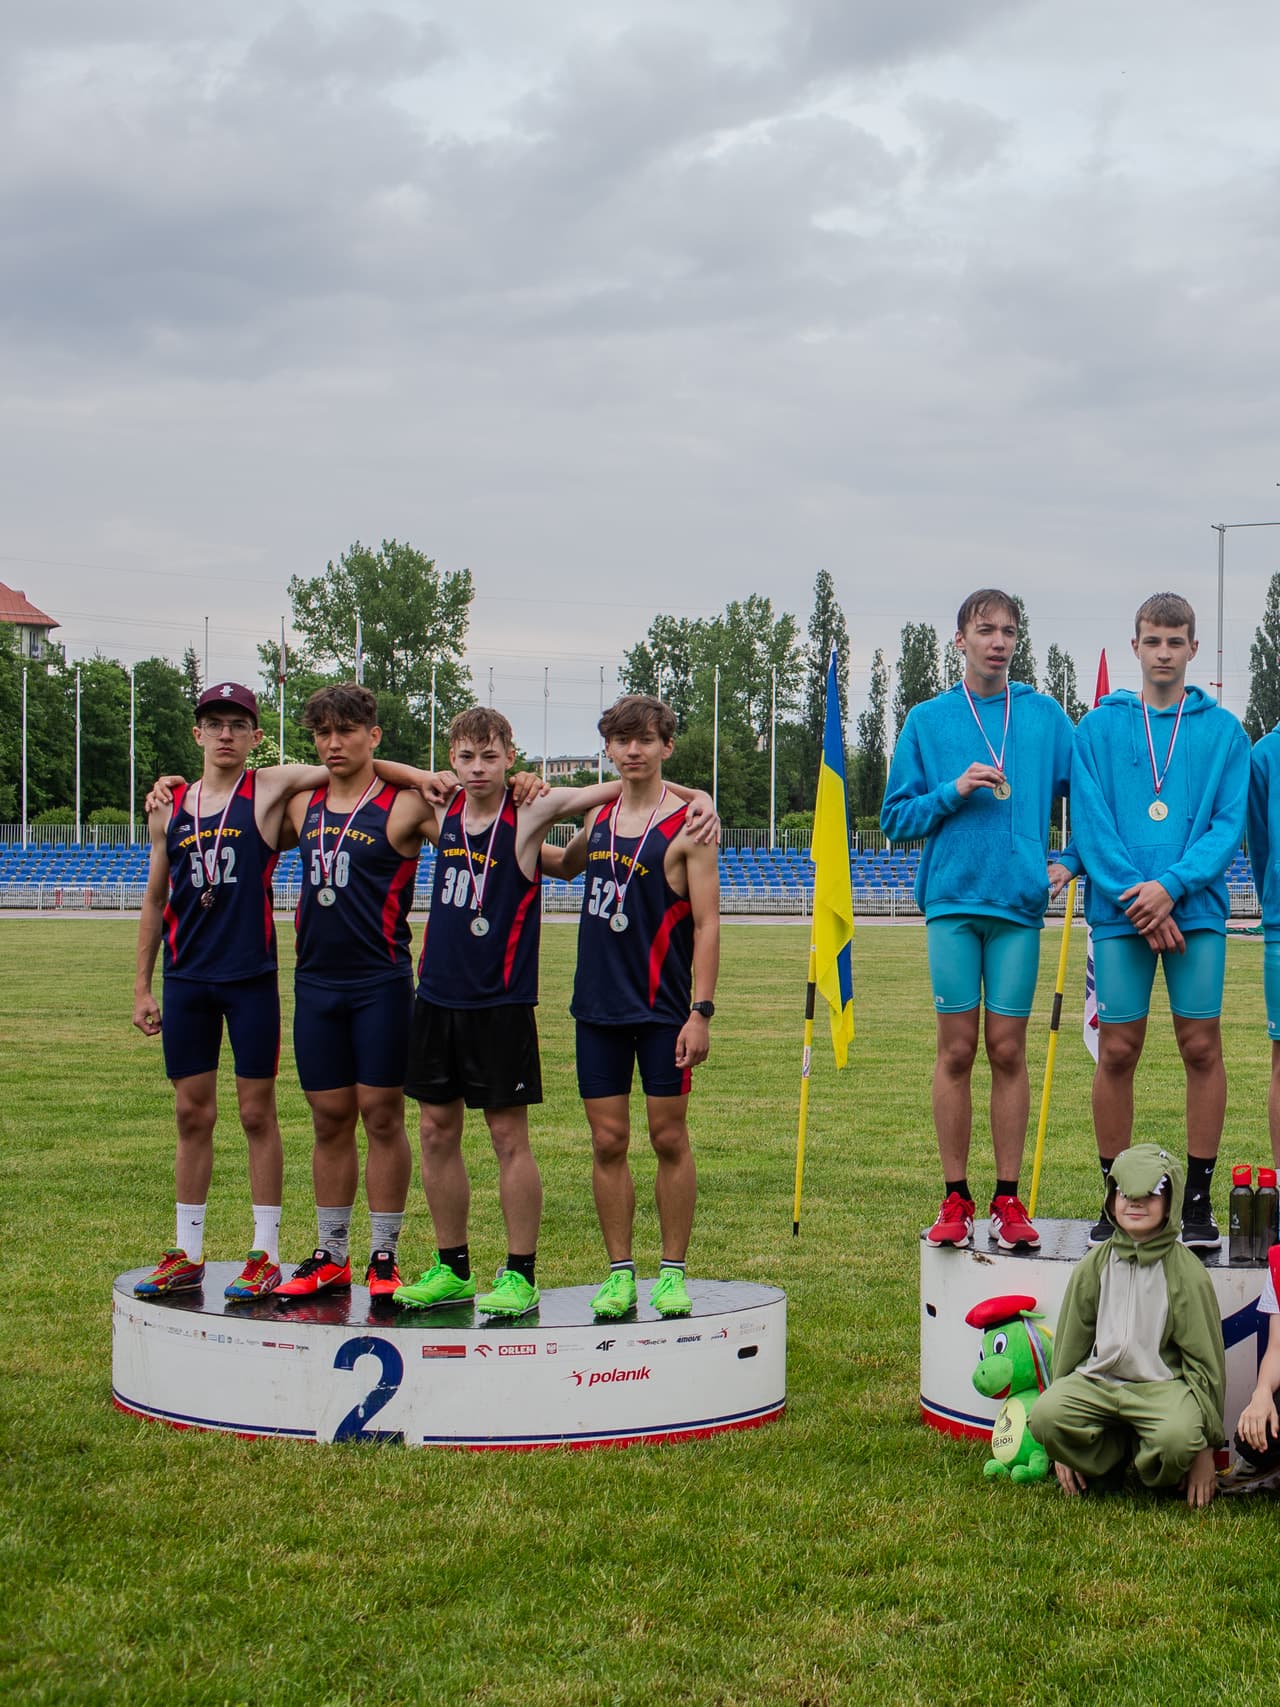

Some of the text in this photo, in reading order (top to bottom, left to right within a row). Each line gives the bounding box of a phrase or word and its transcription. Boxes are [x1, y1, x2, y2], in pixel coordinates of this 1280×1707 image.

[443, 847, 498, 868] TEMP KĘY
[310, 849, 350, 888] 518
[500, 1346, 534, 1355] ORLEN
[596, 1339, 616, 1351] 4F
[588, 1366, 652, 1387] polanik
[333, 1335, 404, 1444] 2
